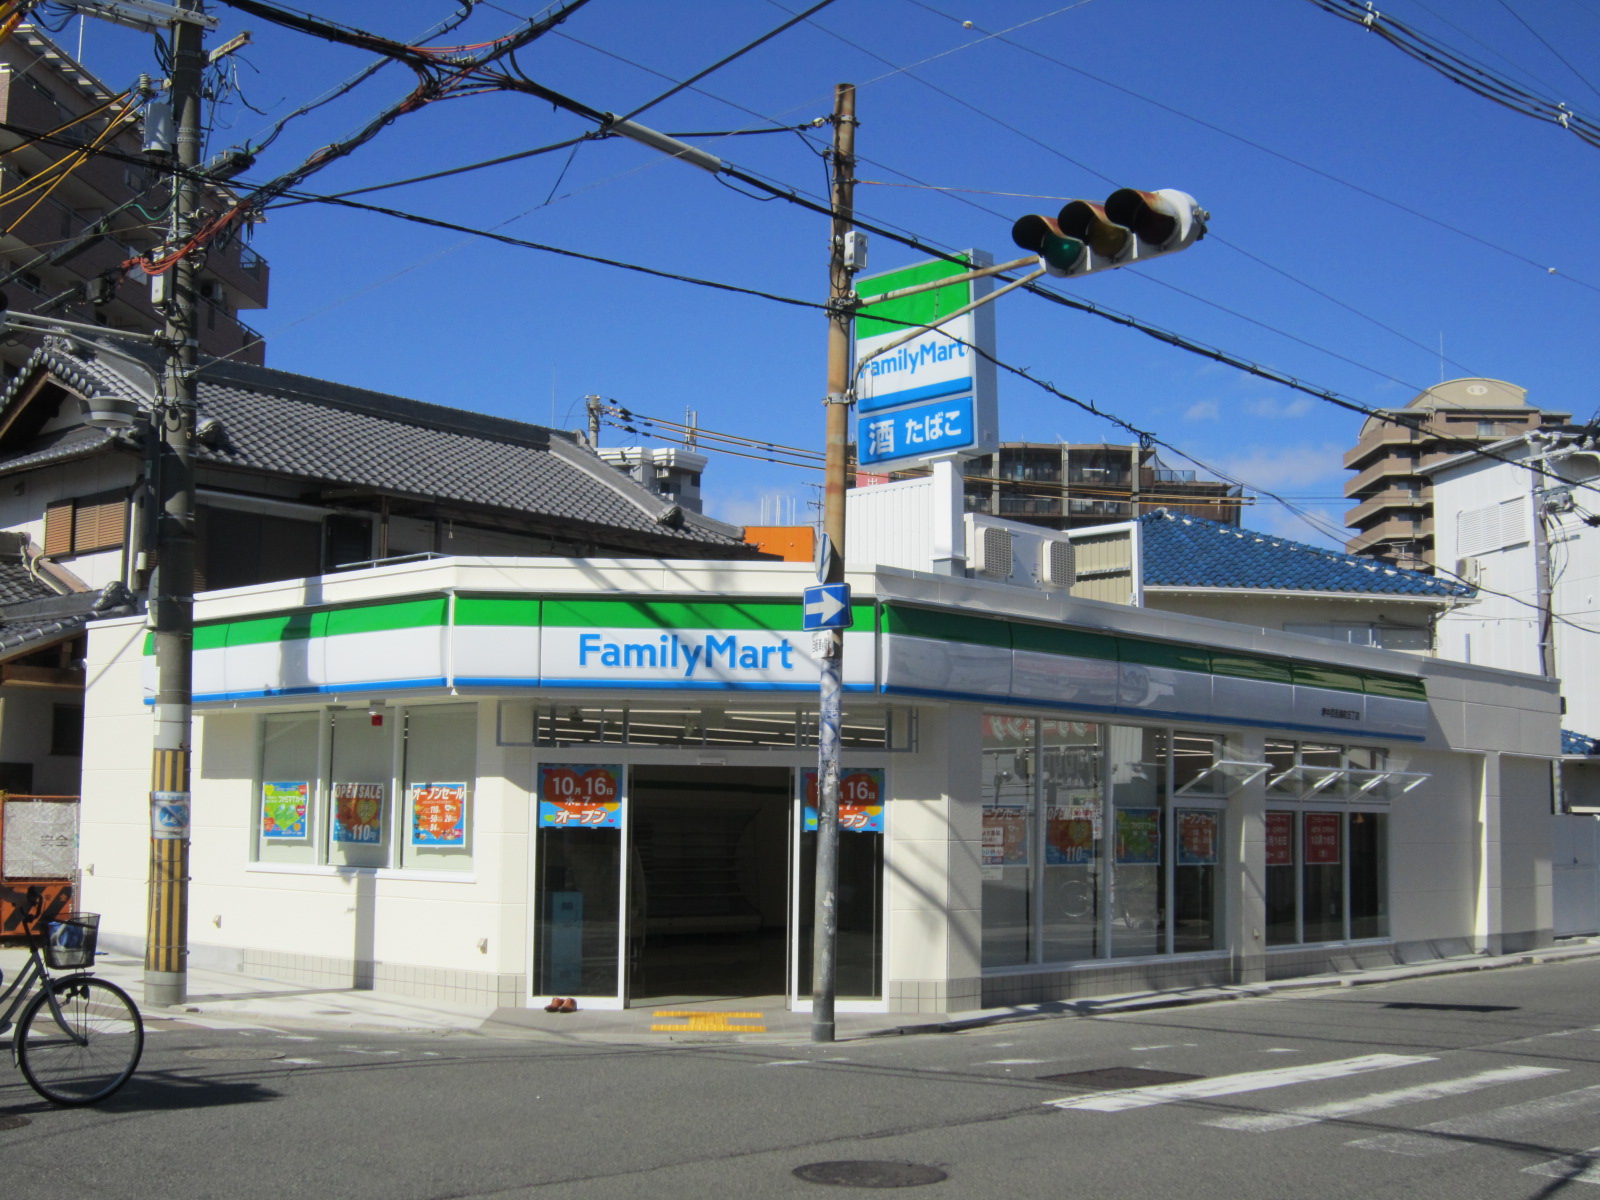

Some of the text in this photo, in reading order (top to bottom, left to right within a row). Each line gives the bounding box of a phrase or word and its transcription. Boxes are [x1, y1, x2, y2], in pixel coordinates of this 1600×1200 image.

[868, 410, 962, 456] 酒 たばこ
[578, 632, 794, 678] FamilyMart
[335, 783, 382, 799] OPEN SALE
[412, 786, 465, 801] オープンセール
[555, 809, 607, 824] オープン
